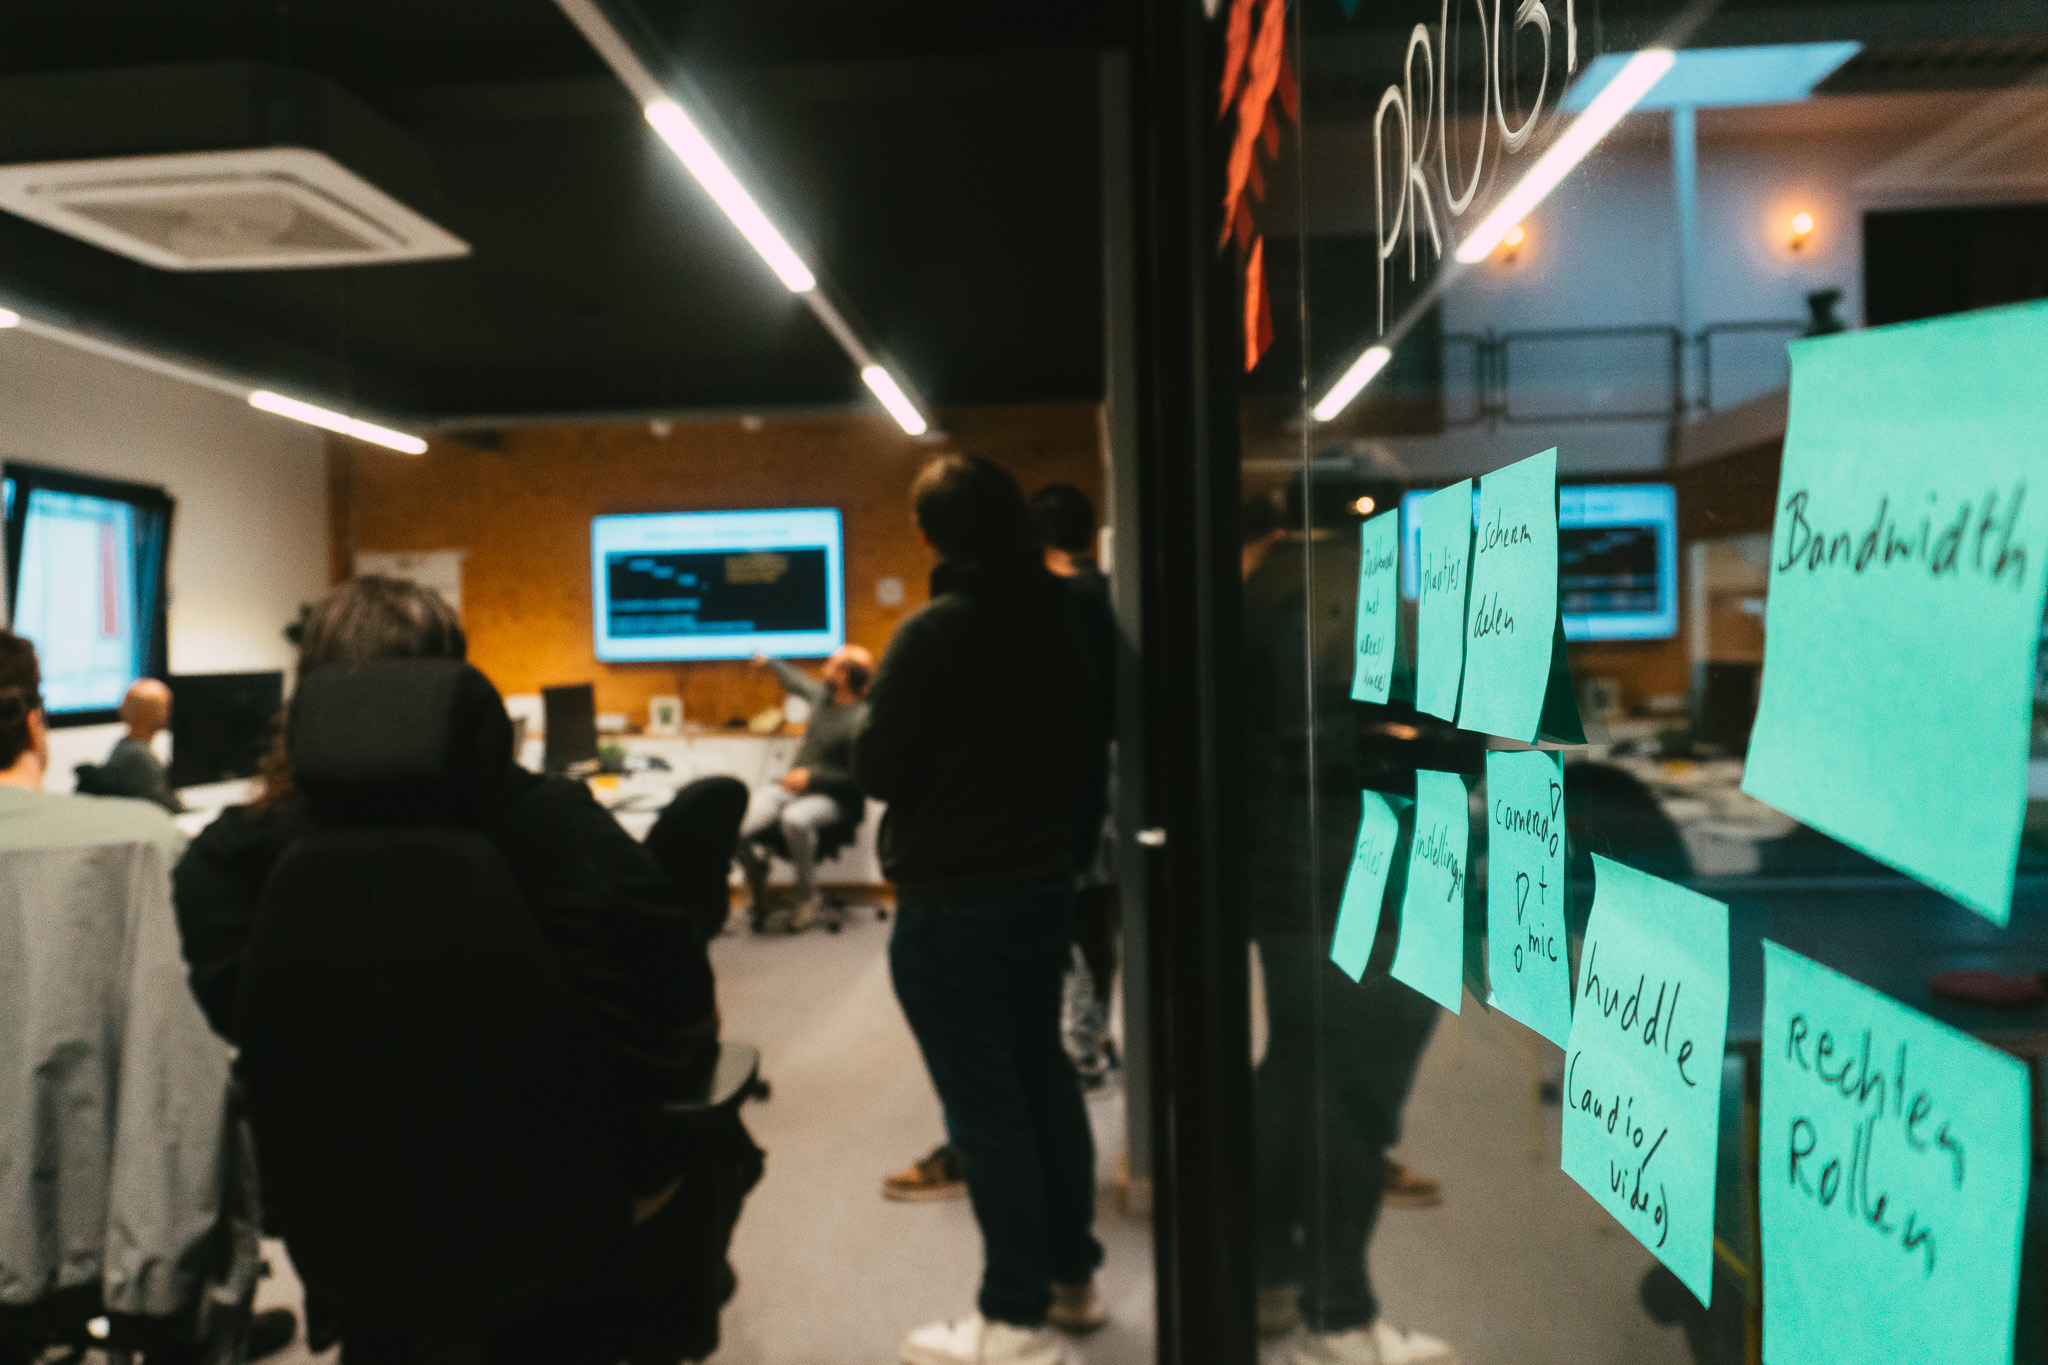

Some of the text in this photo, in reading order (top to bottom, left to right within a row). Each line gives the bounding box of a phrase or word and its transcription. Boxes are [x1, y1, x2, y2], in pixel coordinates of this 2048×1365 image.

[1777, 477, 2028, 590] Bandwidth
[1473, 591, 1515, 639] delen
[1528, 923, 1558, 963] mic
[1584, 941, 1698, 1088] huddle
[1568, 1050, 1669, 1171] (audio/
[1610, 1160, 1669, 1249] video)
[1788, 1115, 1937, 1279] Rollen
